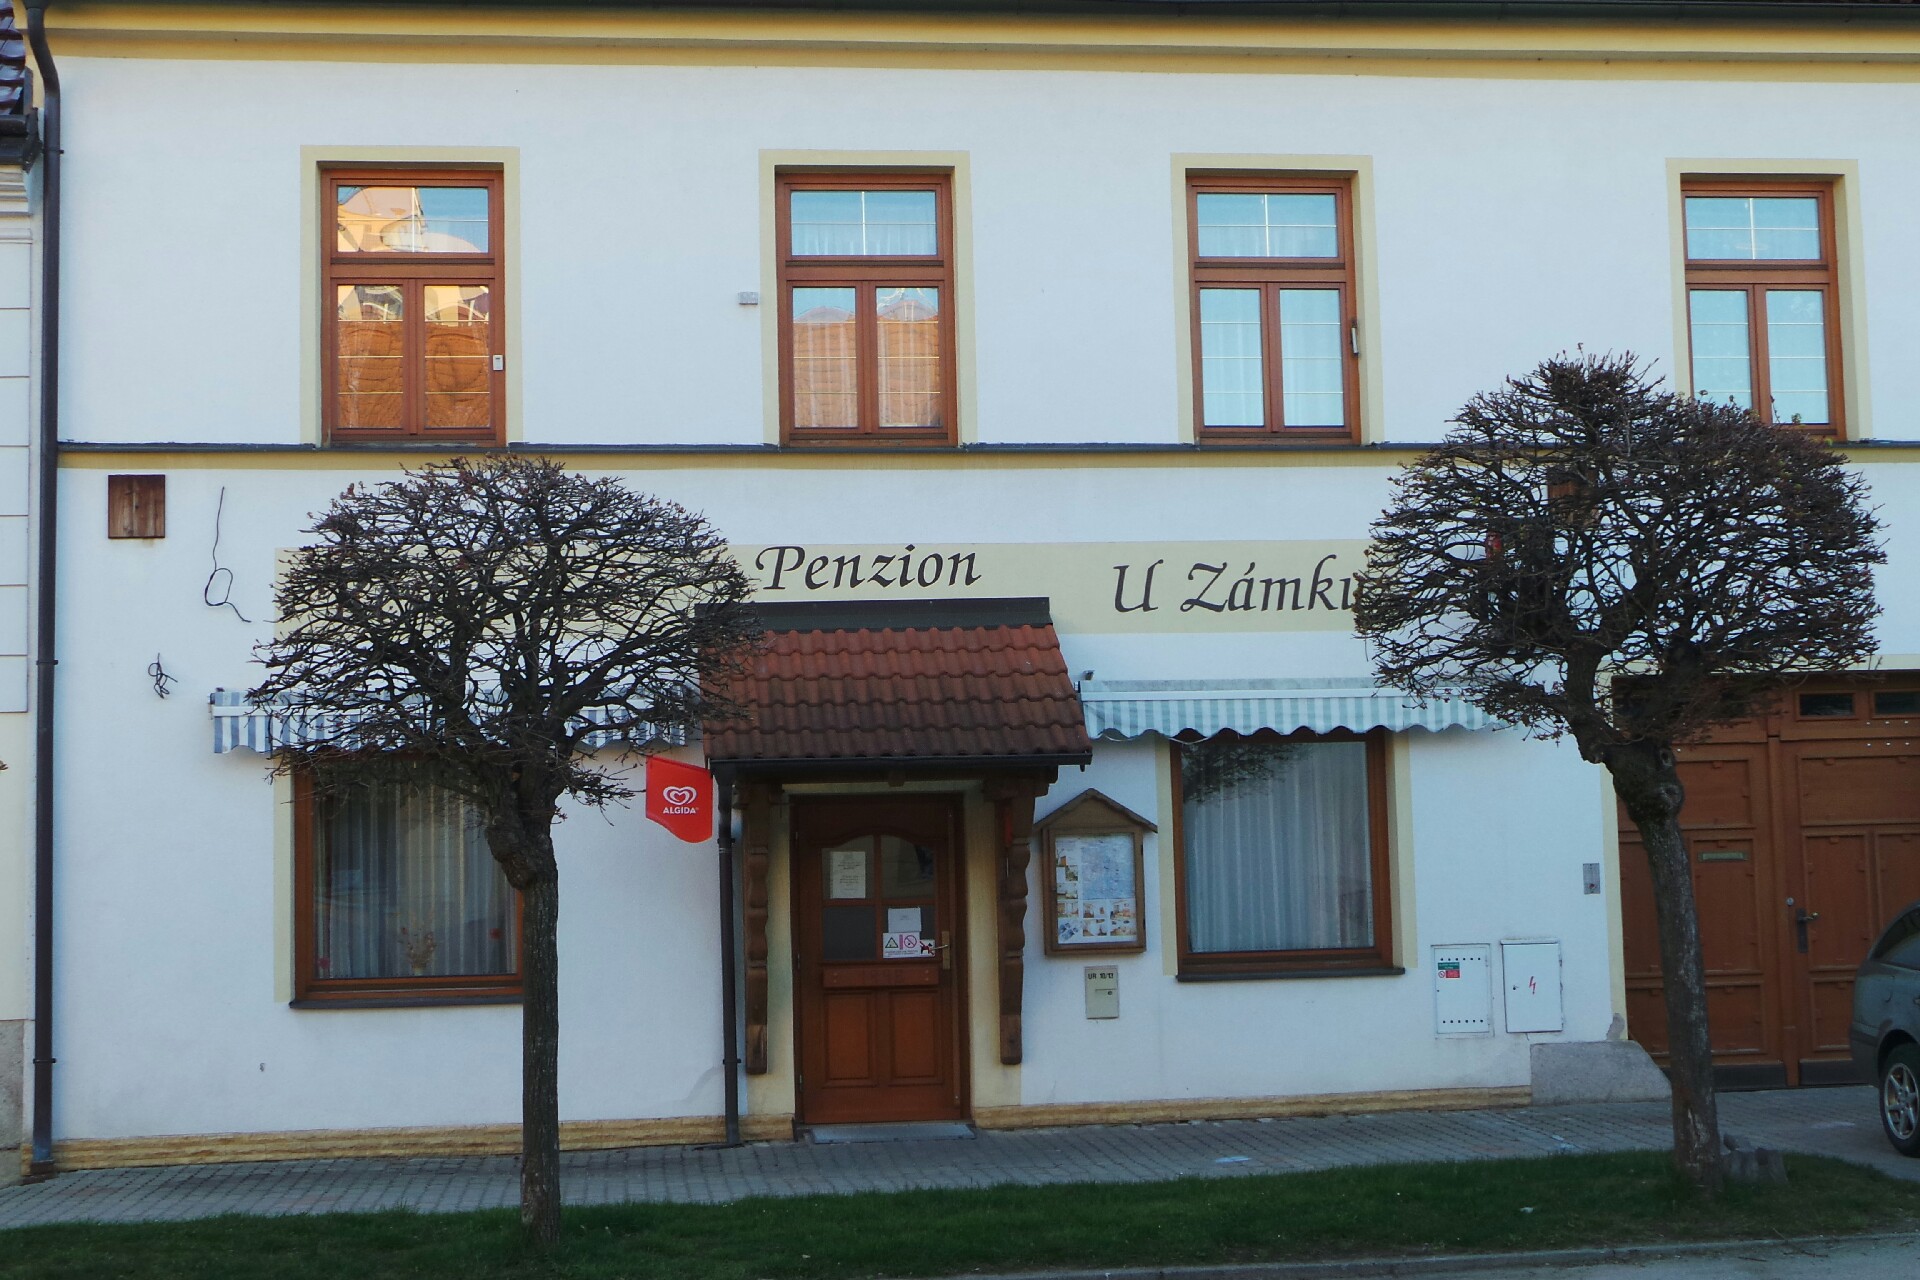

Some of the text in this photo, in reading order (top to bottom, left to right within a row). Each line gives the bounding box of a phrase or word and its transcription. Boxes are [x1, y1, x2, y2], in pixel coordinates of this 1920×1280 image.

[755, 543, 982, 590] Penzion
[1113, 559, 1164, 612] U
[662, 806, 697, 815] ALGIDA
